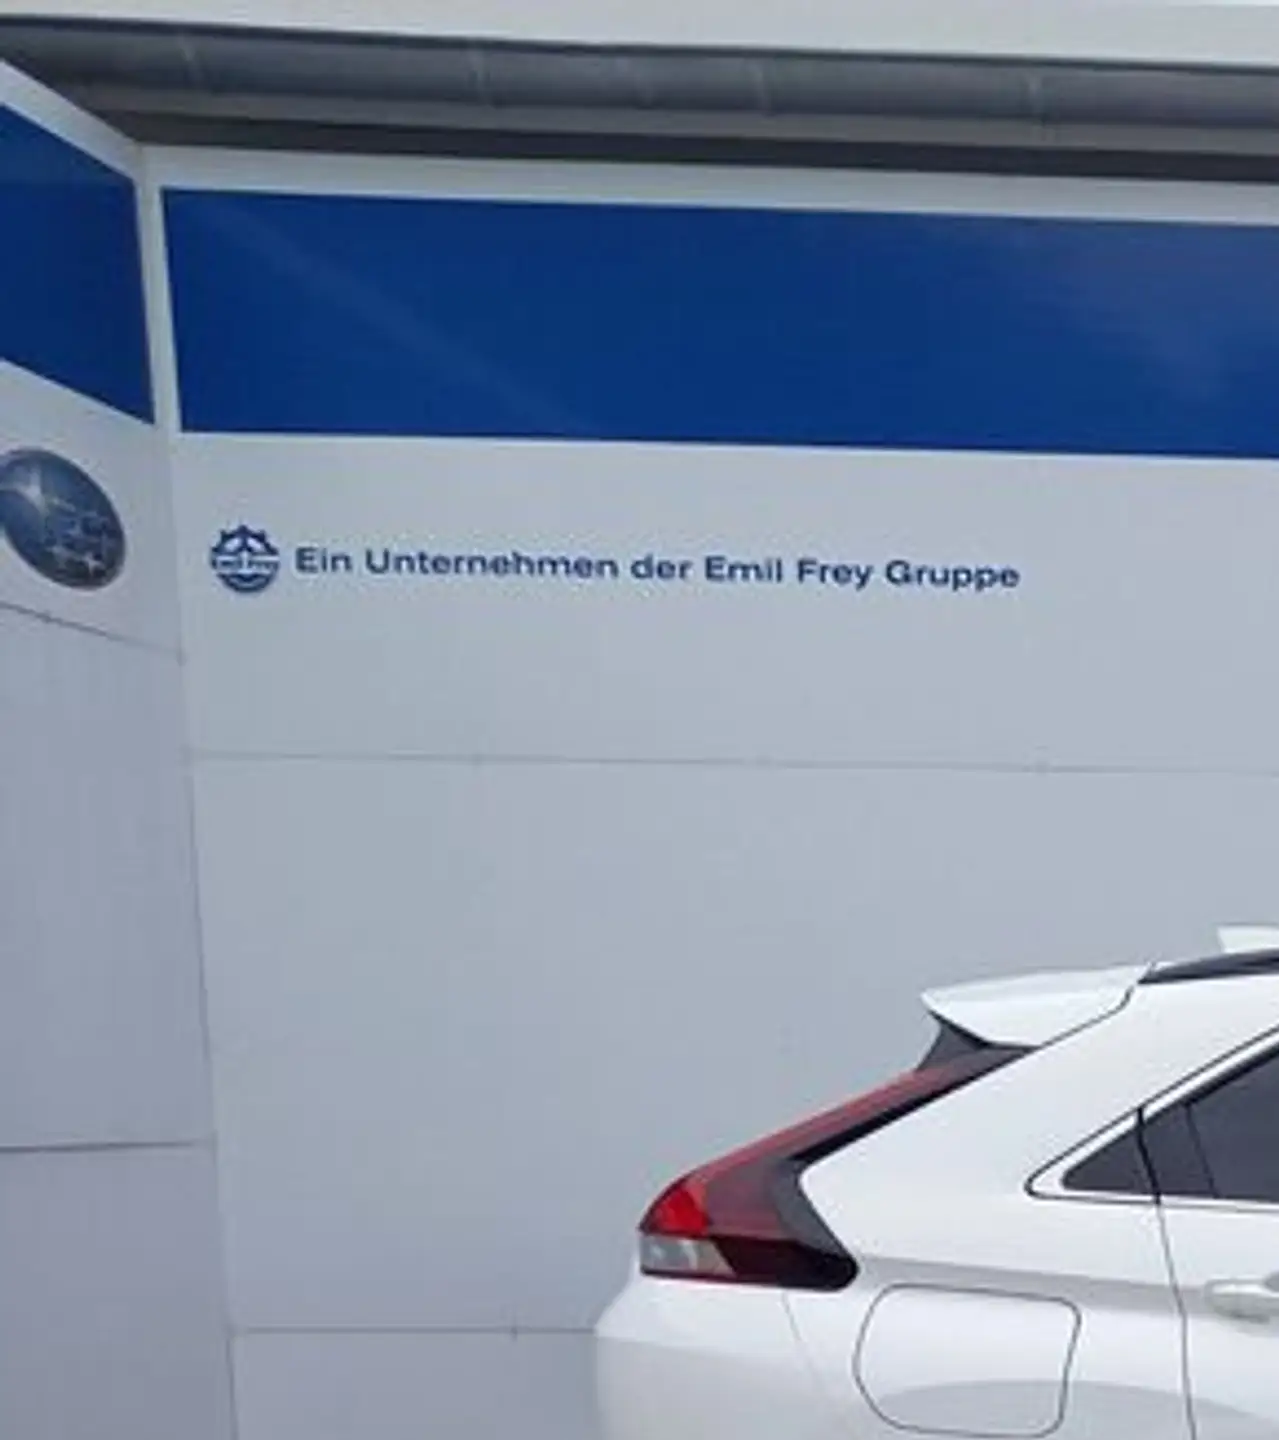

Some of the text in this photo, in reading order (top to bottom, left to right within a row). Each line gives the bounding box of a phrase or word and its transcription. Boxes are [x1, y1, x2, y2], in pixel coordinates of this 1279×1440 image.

[294, 546, 352, 575] Ein
[365, 547, 619, 579] Unternehmen
[630, 554, 692, 582] der
[704, 555, 783, 584] Emil
[797, 558, 874, 591] Frey
[885, 559, 1021, 592] Gruppe
